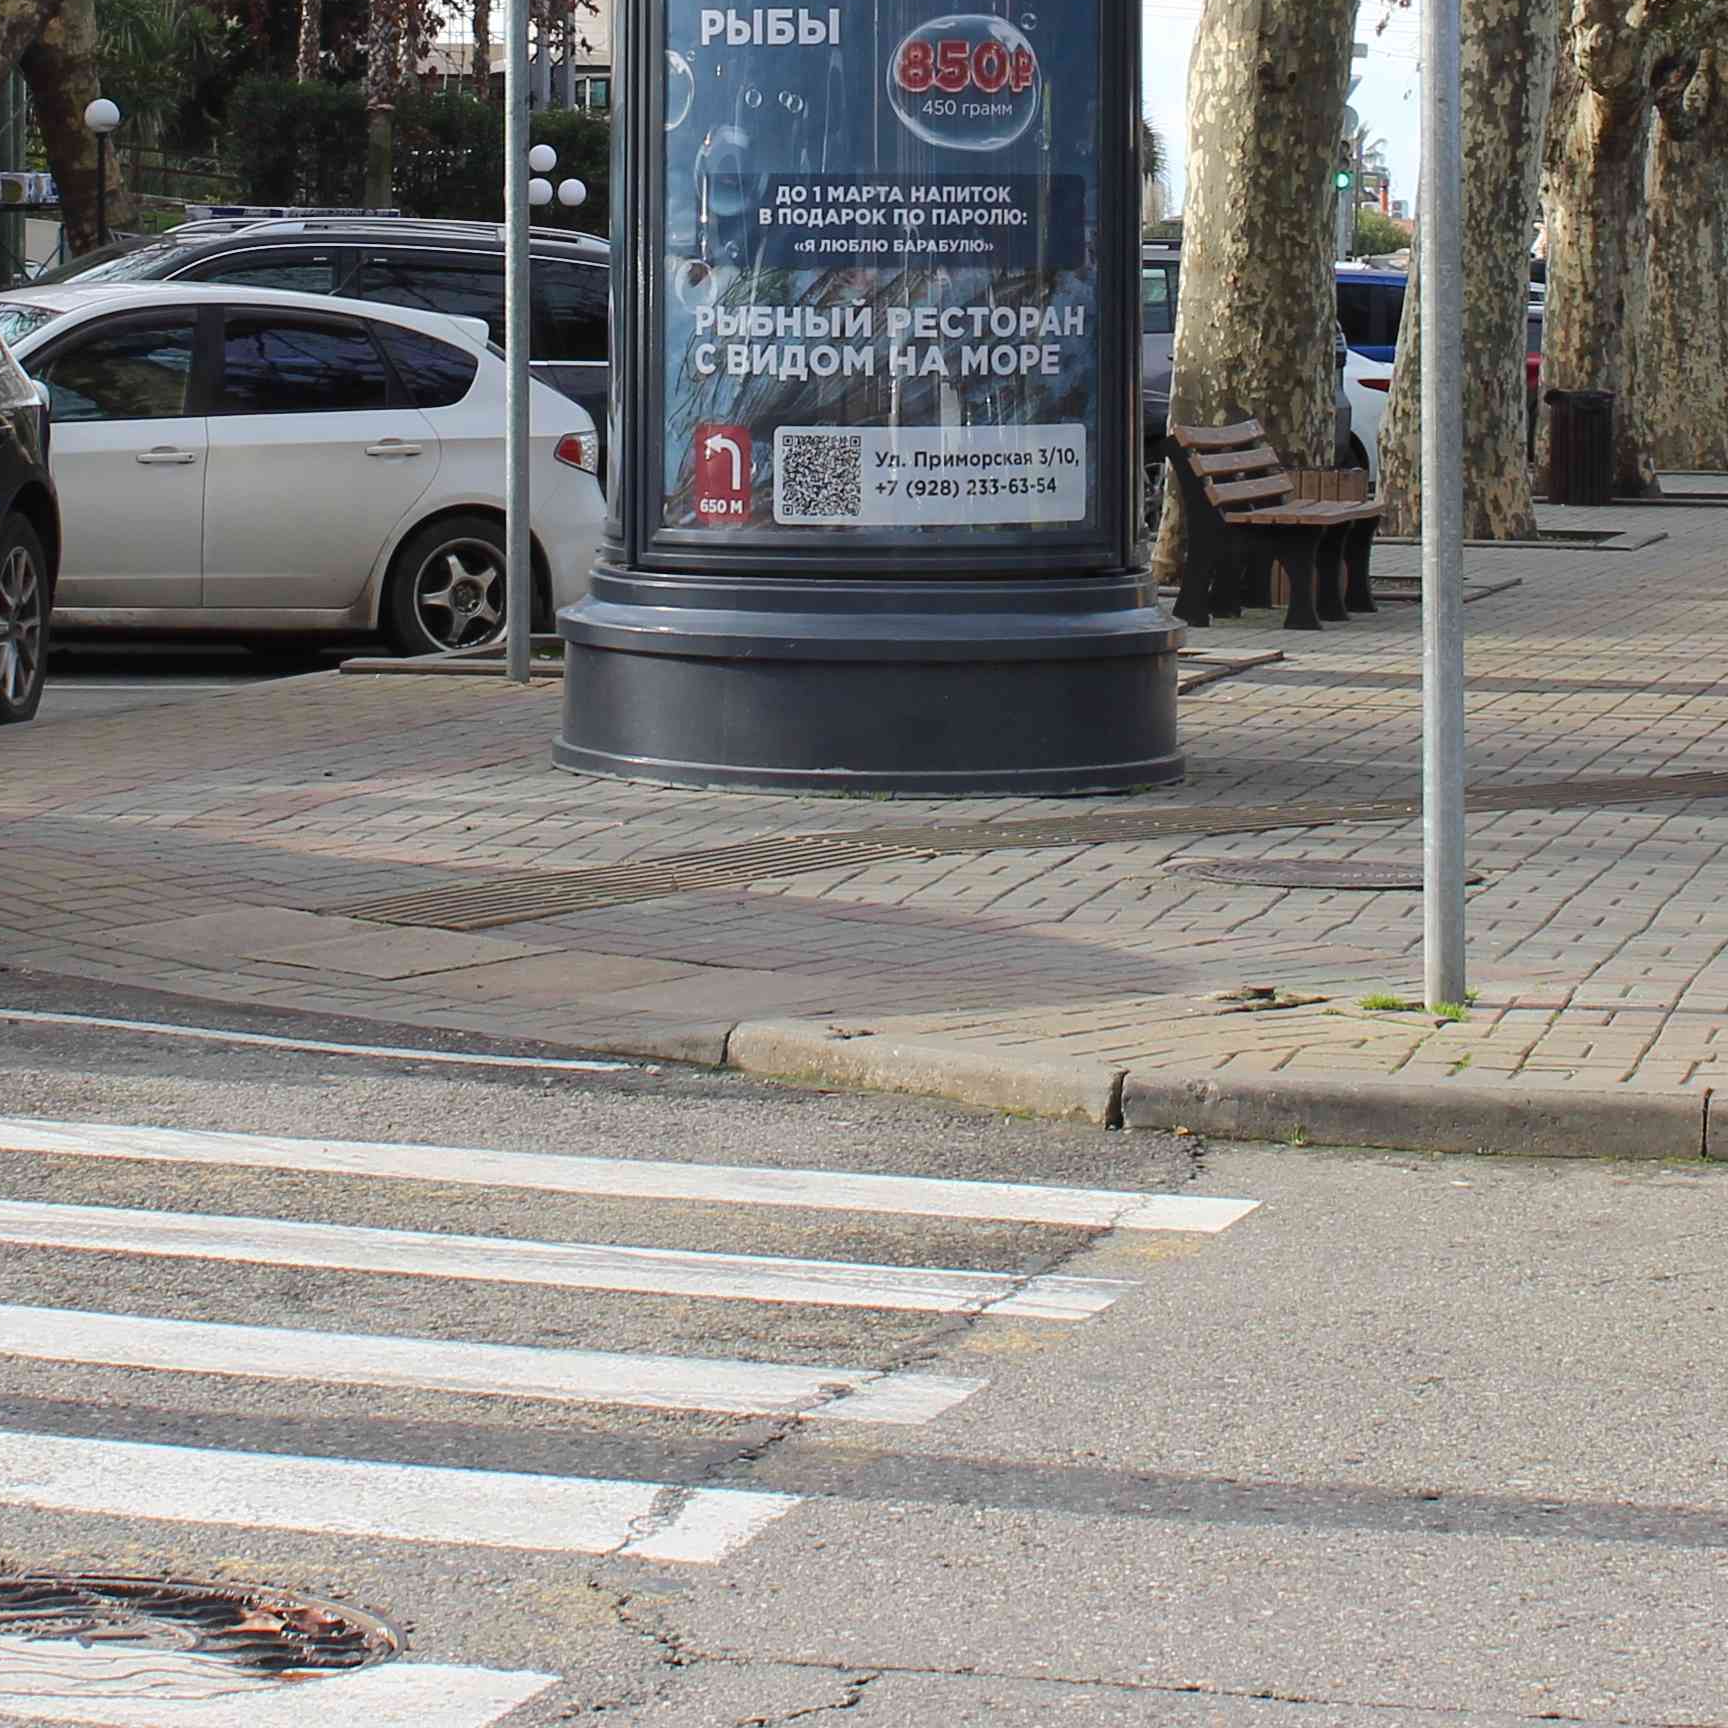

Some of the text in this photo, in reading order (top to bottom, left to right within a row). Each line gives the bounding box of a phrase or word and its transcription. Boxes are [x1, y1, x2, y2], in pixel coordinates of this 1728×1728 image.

[700, 8, 840, 46] РЫБЫ
[922, 100, 1013, 119] 450 грамм
[775, 186, 1011, 205] ДО 1 МАРТА НАПИТОК
[759, 208, 1028, 228] В ПОДАРОК ПО ПАРОЛЮ:
[794, 239, 994, 253] «Я ЛЮБЛЮ БАРАБУЛЮ»
[695, 299, 1085, 338] РЫБНЫЙ РЕСТОРАН
[695, 344, 1060, 381] С ВИДОМ НА МОРЕ
[875, 447, 1080, 472] Ул. Приморская 3/10,
[875, 477, 1056, 498] +7 (928) 233-63-54
[699, 499, 744, 514] 650 М
